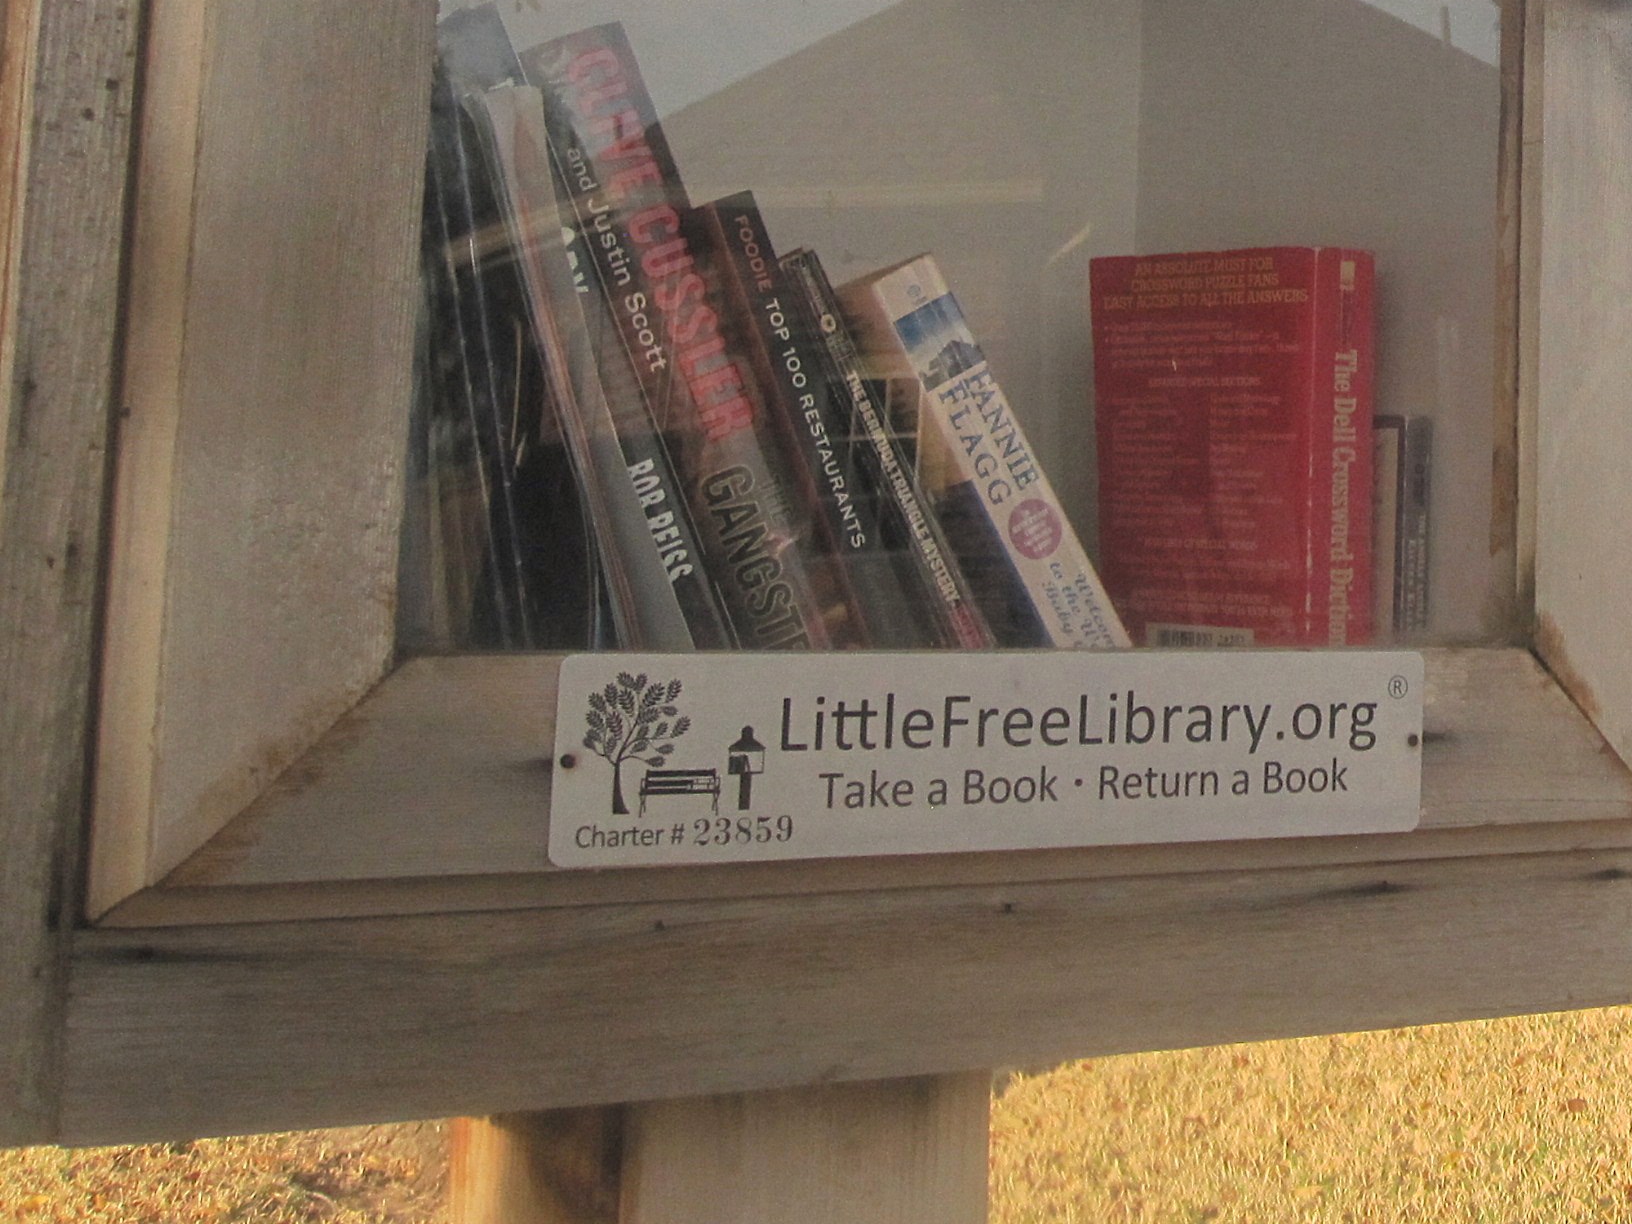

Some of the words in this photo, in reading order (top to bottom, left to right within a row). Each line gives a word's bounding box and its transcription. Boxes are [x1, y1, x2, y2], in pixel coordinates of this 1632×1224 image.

[566, 147, 596, 192] and
[586, 196, 633, 285] Justin
[624, 291, 668, 373] Scott
[569, 49, 665, 200] CLIVE
[628, 204, 756, 441] CUSSLER
[1130, 275, 1202, 293] CROSSWORD
[1204, 274, 1245, 290] PUZZLE
[1247, 273, 1279, 287] FANS
[733, 214, 773, 292] FOODIE
[764, 298, 790, 342] TOP
[782, 349, 807, 388] 100
[799, 394, 866, 548] RESTAURANTS
[1334, 351, 1358, 391] The
[938, 383, 1012, 506] FLAGG
[966, 369, 1039, 490] FANNIE
[1333, 397, 1356, 441] Dell
[845, 369, 865, 401] THE
[857, 400, 898, 472] BERMUDA
[889, 469, 928, 539] TRIANGLE
[757, 475, 794, 521] THE
[1331, 448, 1357, 560] Crossword
[1048, 559, 1066, 580] to
[1060, 583, 1084, 615] the
[780, 690, 1378, 755] LittleFreeLibrary.org
[818, 769, 914, 809] Take
[926, 778, 948, 806] a
[963, 765, 1058, 805] Book
[1099, 766, 1219, 800] Return
[1231, 769, 1250, 796] a
[1263, 757, 1348, 795] Book
[575, 824, 664, 848] Charter
[693, 814, 794, 846] 23859
